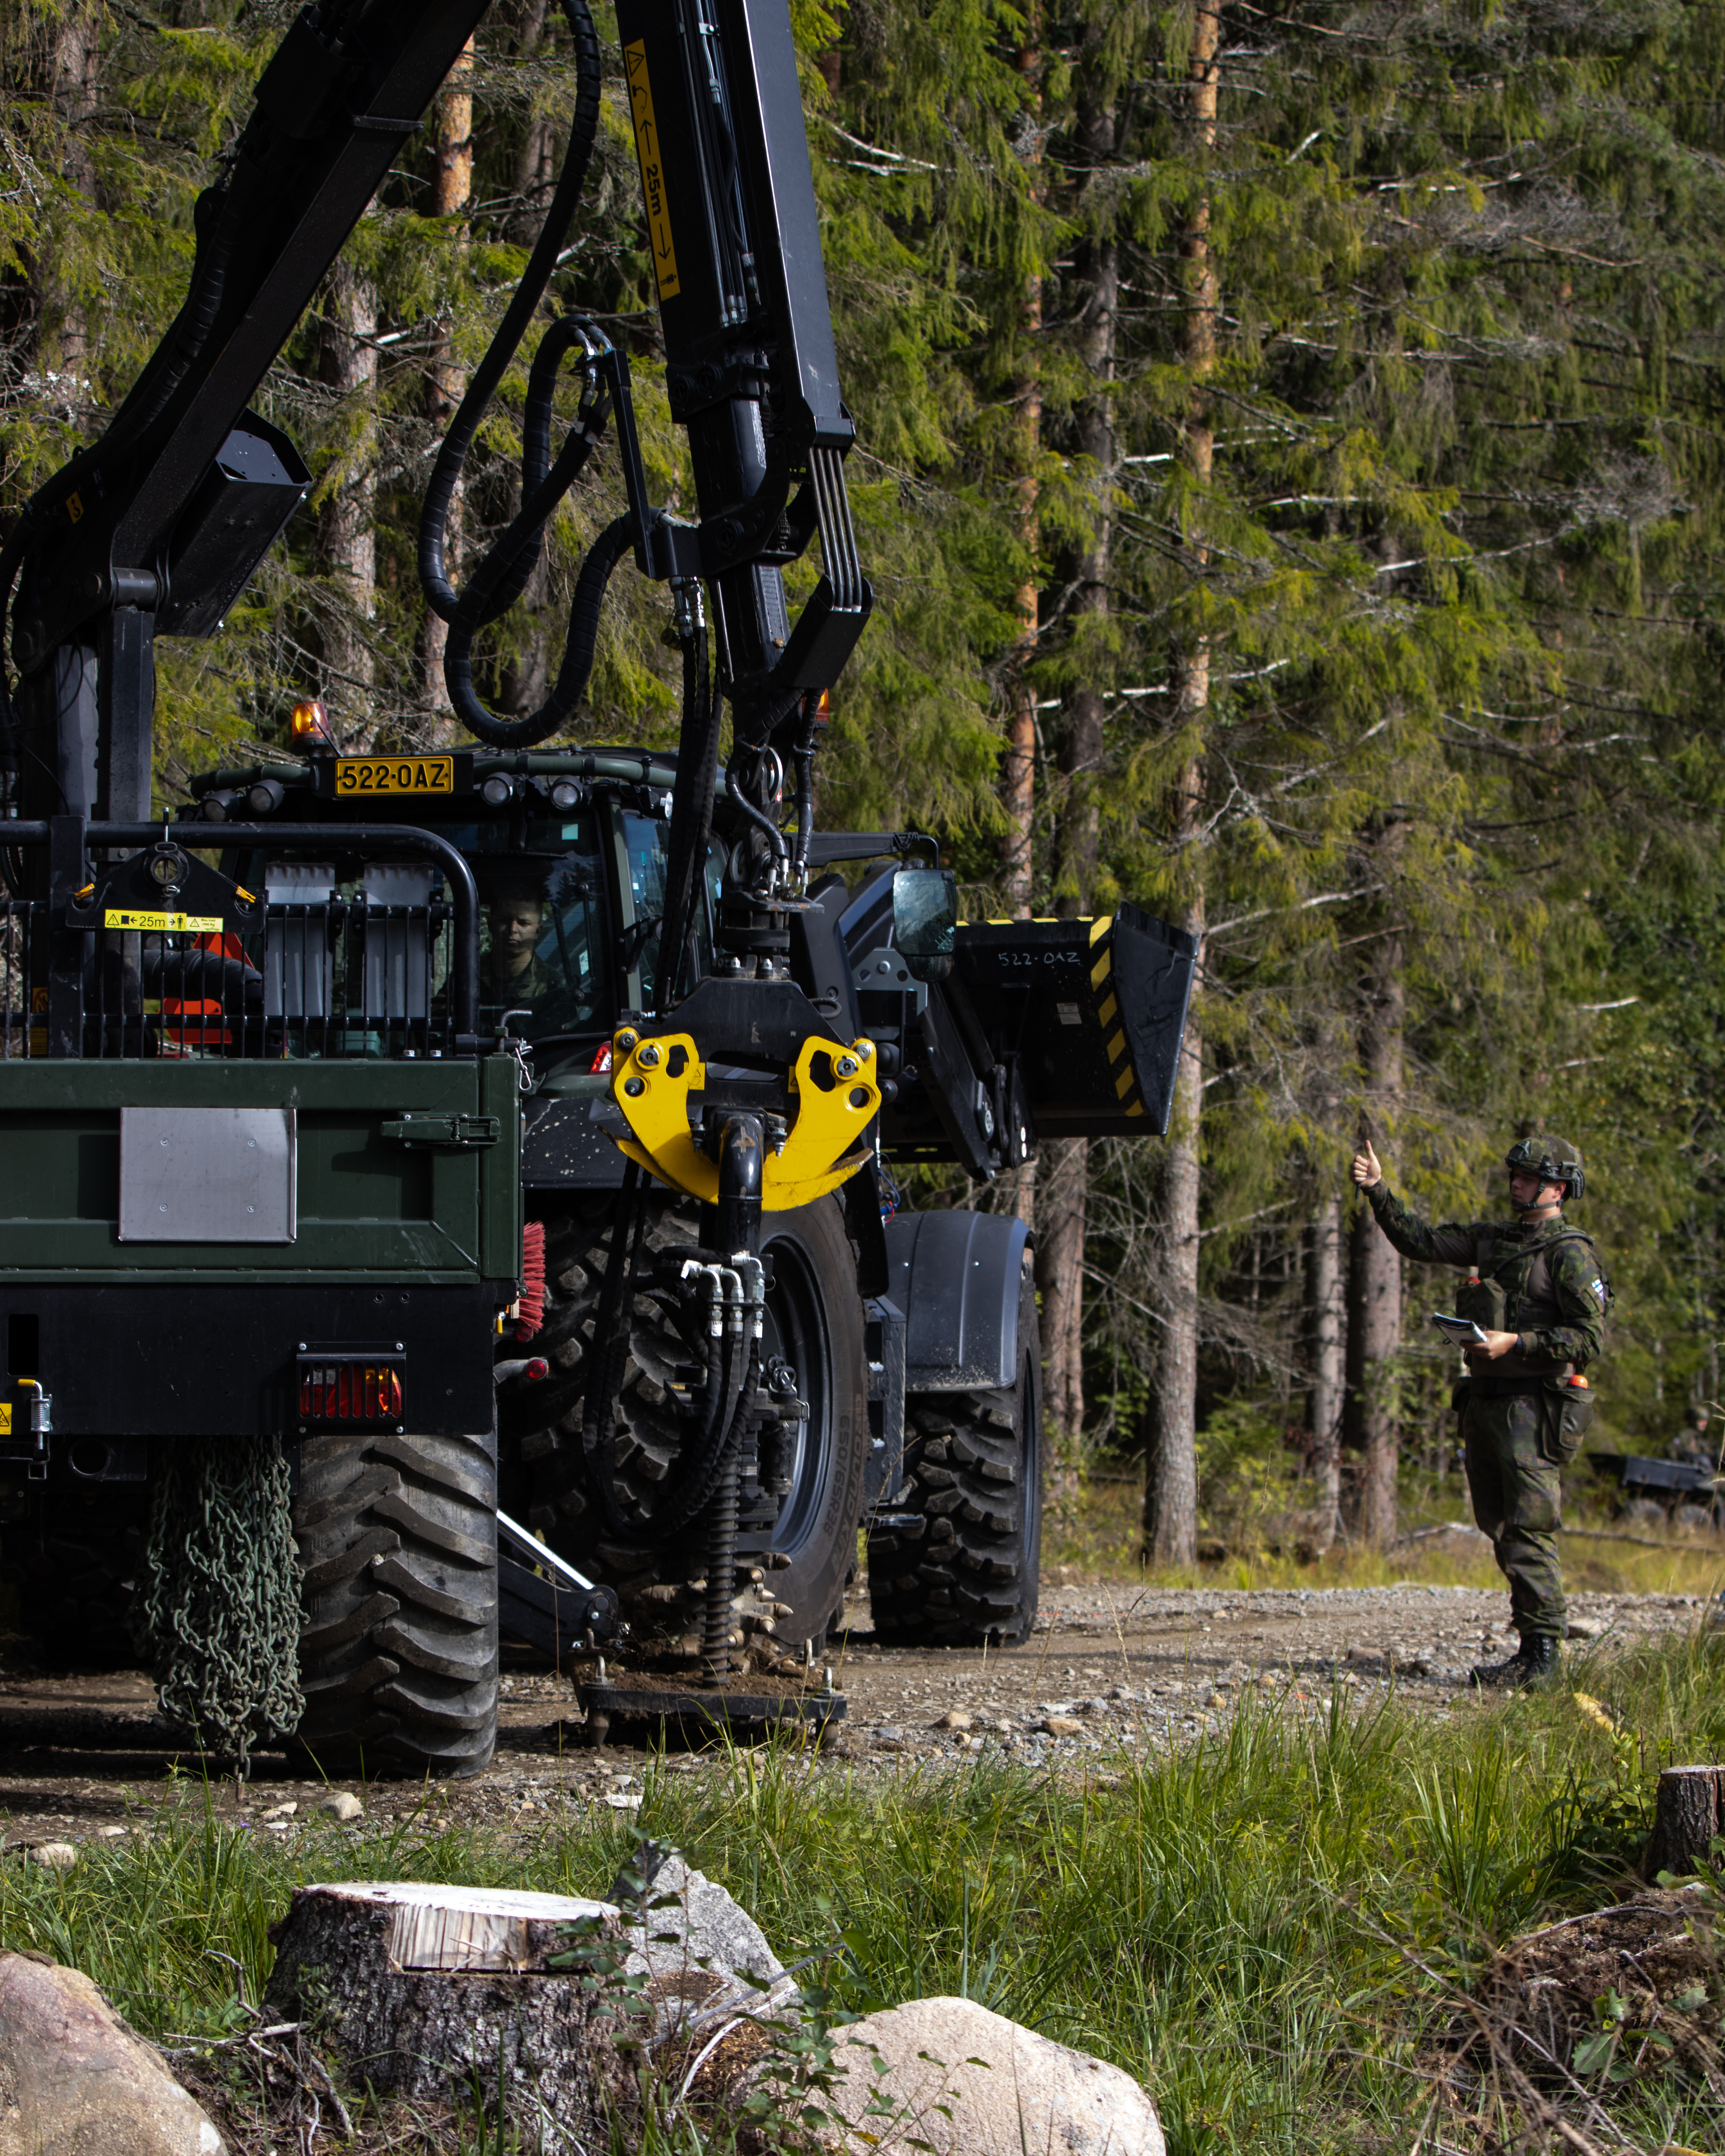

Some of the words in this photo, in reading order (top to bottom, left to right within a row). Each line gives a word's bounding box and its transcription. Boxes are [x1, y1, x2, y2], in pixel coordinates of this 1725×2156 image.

[646, 164, 661, 216] 25m
[342, 763, 445, 789] 522-OAZ
[139, 916, 165, 927] 25m
[999, 953, 1080, 966] 522-OAZ
[823, 1415, 850, 1537] 650/65R38
